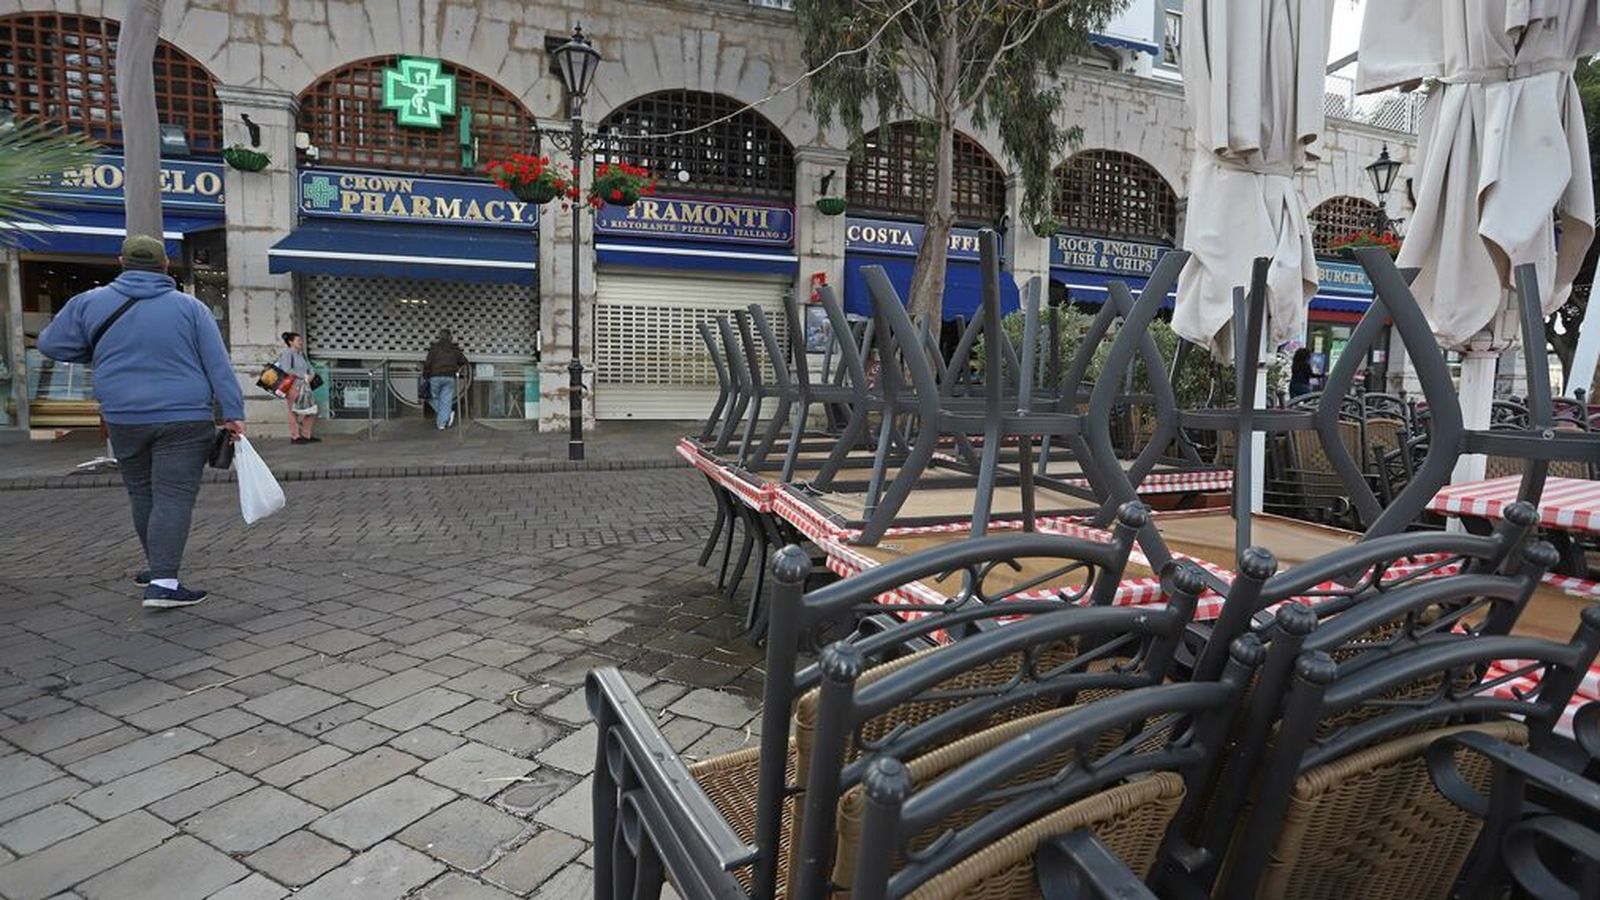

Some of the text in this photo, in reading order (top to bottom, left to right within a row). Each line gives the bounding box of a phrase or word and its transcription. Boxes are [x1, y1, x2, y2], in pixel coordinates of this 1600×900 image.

[339, 176, 415, 194] CROWN
[339, 190, 528, 222] PHARMACY
[626, 201, 769, 229] TRAMONTI
[610, 220, 677, 232] RISTORANTE
[681, 225, 728, 236] PIZZERIA
[733, 228, 780, 239] ITALIANO
[847, 225, 914, 246] COSTA
[1057, 237, 1158, 260] ROCK ENGLISH
[1063, 251, 1153, 273] FISH & CHIPS
[1318, 268, 1365, 285] BURGER
